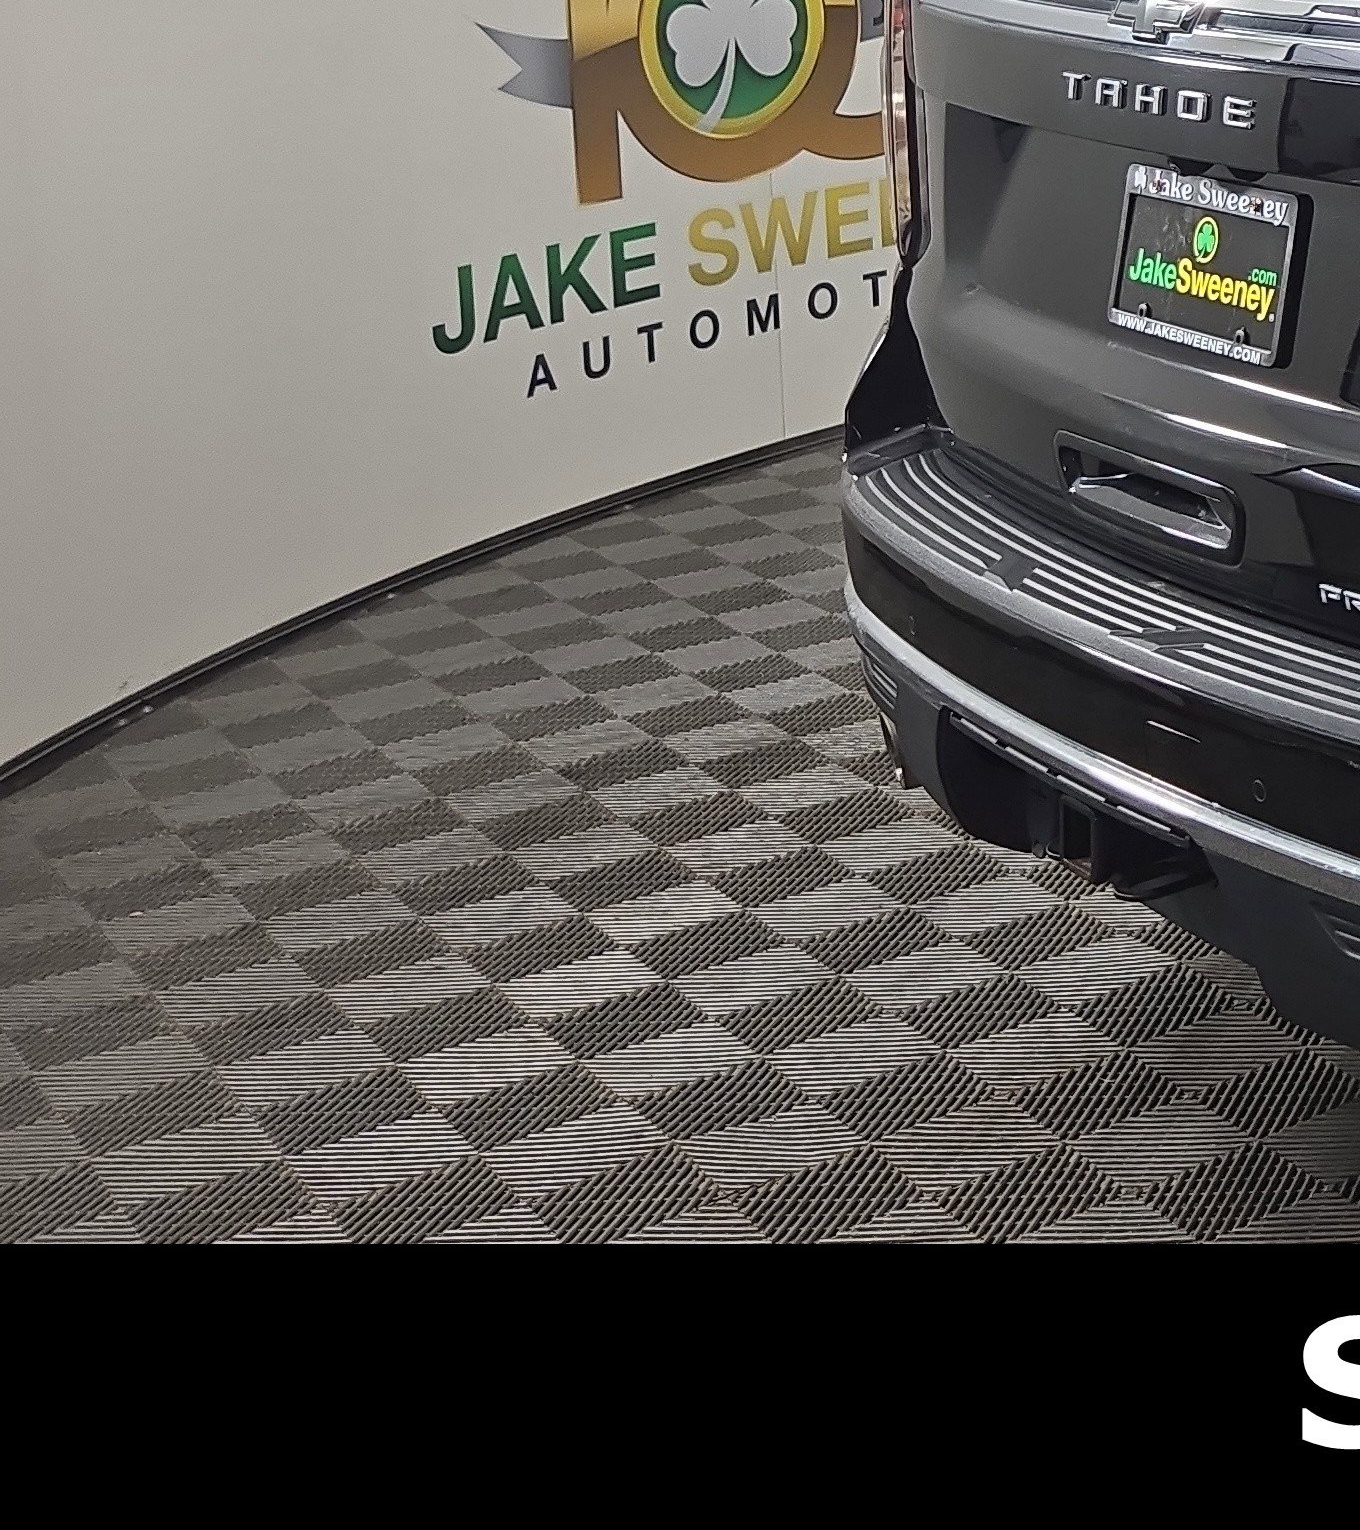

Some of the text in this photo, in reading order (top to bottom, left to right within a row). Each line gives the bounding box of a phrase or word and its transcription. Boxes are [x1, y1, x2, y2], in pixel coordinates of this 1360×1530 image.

[1063, 70, 1257, 130] TAHOE
[1149, 168, 1290, 227] Jake Sweeney
[432, 222, 662, 355] JAKE
[1247, 268, 1278, 287] .com
[1117, 312, 1261, 366] WWW.JAKESWEENEY.COM
